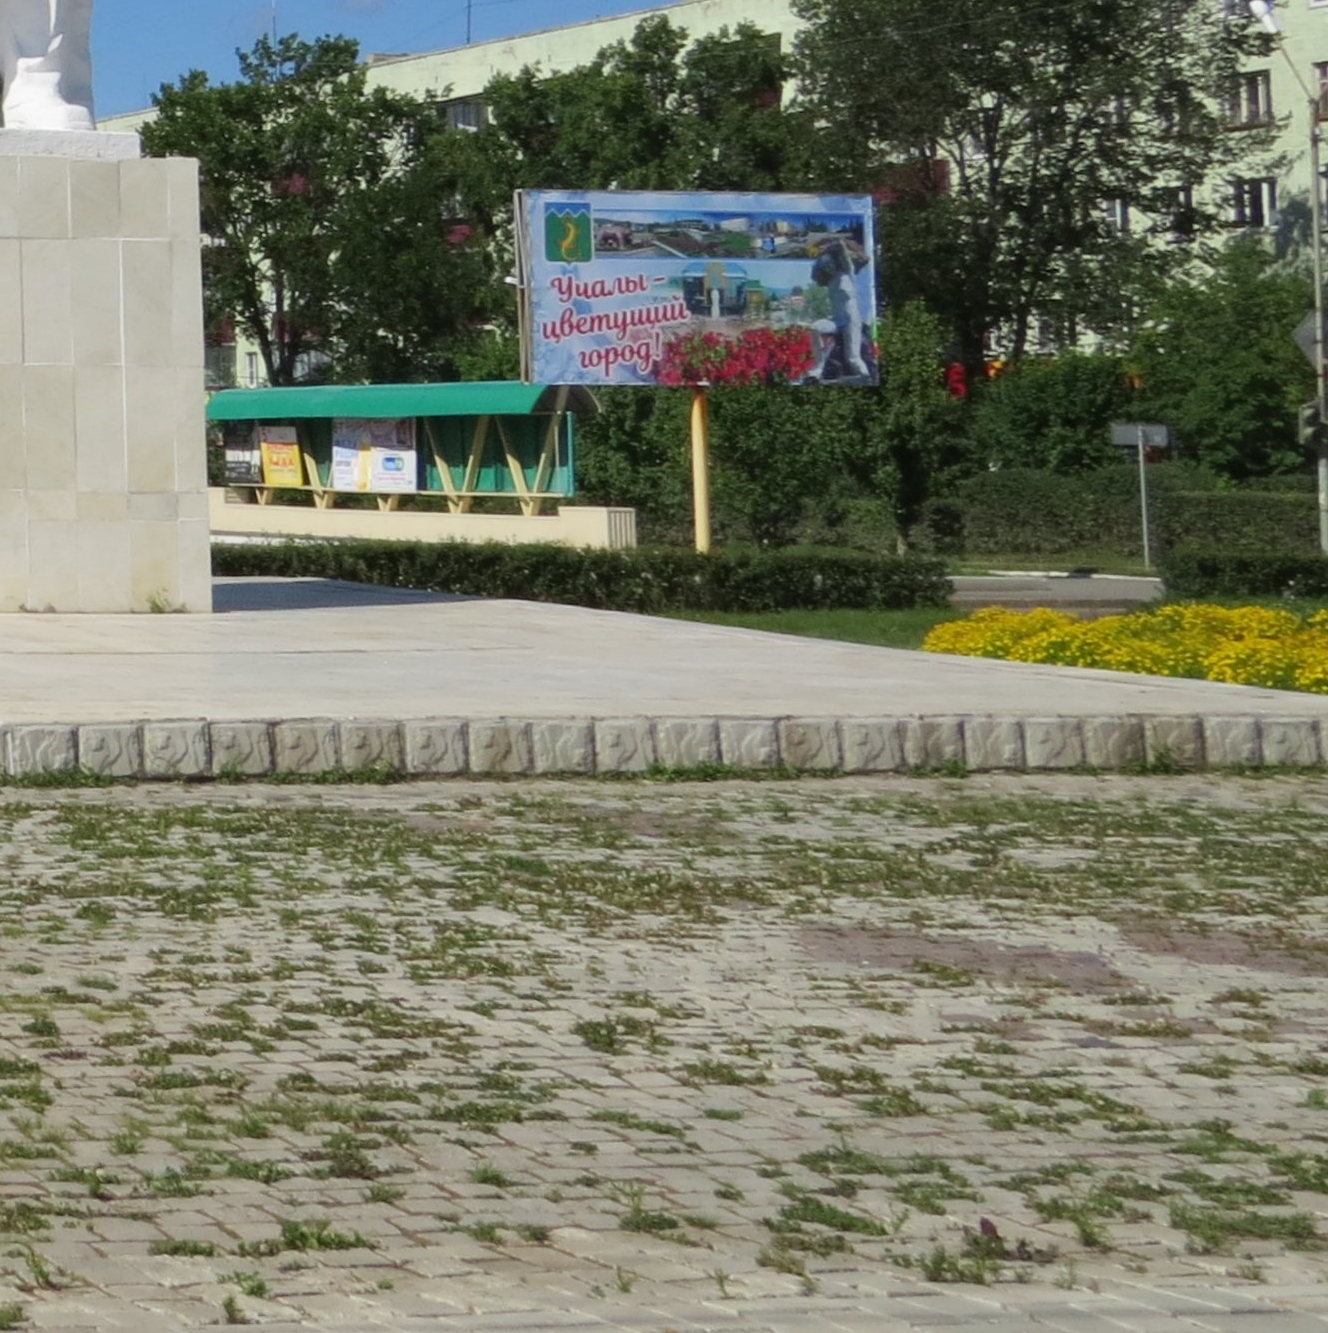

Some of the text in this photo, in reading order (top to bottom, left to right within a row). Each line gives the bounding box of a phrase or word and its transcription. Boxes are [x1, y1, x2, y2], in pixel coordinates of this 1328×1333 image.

[550, 274, 647, 301] Учалы
[542, 297, 688, 344] цветущий
[579, 332, 662, 376] город!
